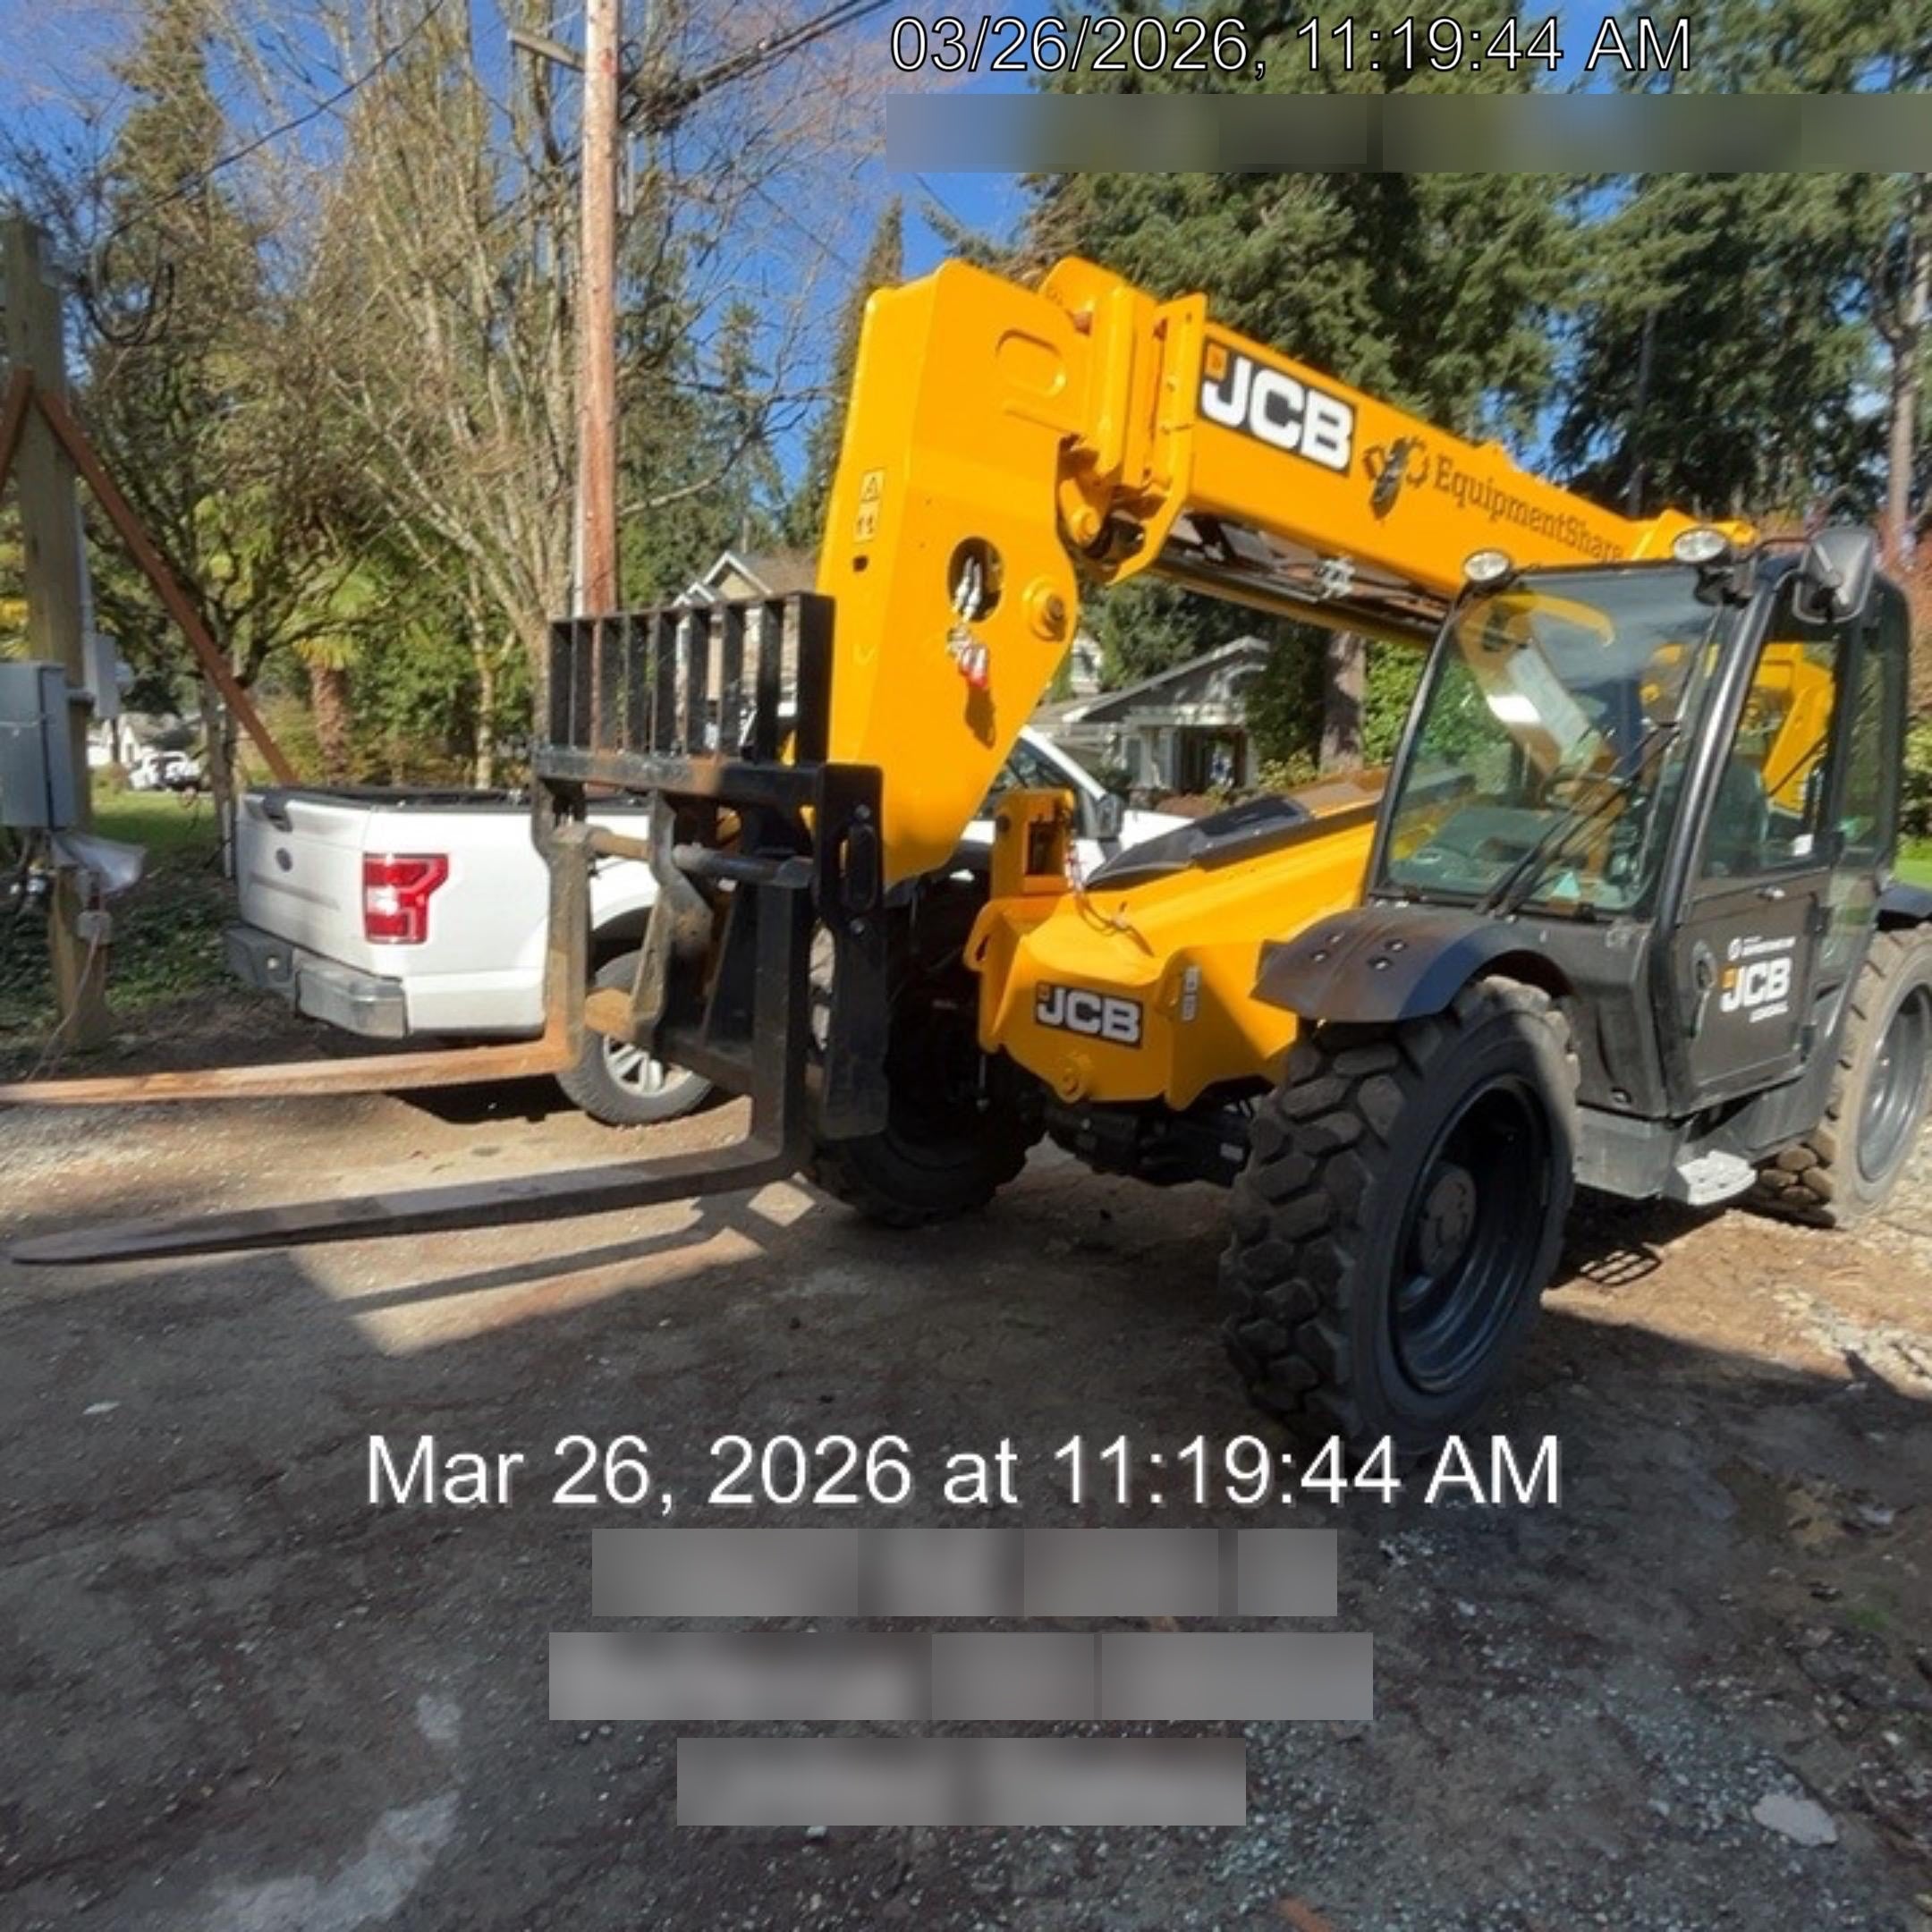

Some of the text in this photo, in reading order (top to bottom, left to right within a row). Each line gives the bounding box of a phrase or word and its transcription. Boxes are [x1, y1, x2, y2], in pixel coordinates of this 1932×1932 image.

[1201, 356, 1353, 470] JCB
[1433, 453, 1624, 562] EquipmentShare
[1037, 986, 1140, 1043] JCB
[1719, 957, 1792, 1013] JCB
